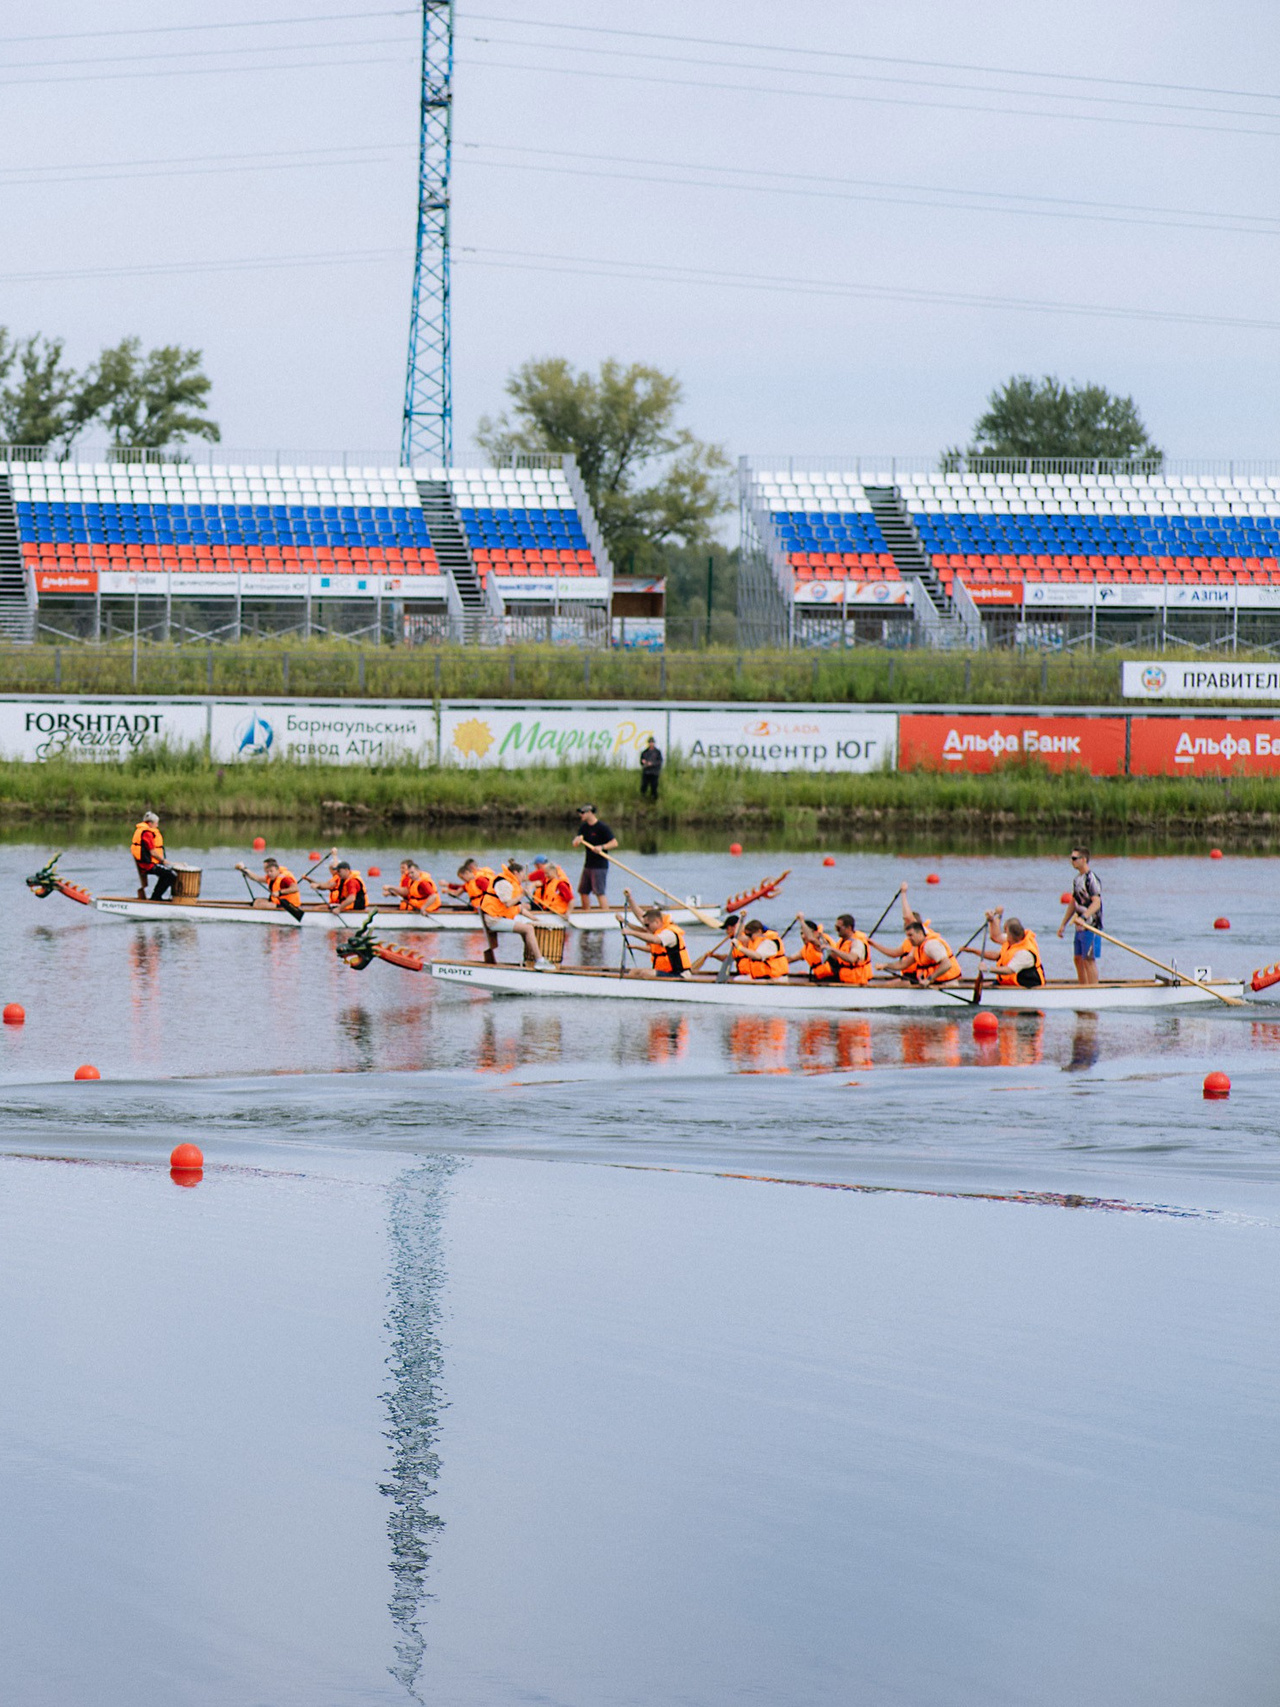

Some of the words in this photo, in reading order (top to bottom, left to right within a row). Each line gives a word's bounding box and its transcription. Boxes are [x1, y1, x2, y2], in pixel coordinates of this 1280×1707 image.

[25, 712, 164, 734] FORSHTADT
[287, 714, 418, 737] Барнаульский
[36, 728, 146, 760] Brewery
[288, 742, 340, 757] завод
[346, 739, 384, 756] АТИ
[691, 739, 827, 763] Автоцентр
[836, 740, 877, 760] ЮГ
[942, 729, 1018, 760] Альфа
[1023, 730, 1081, 754] Банк
[1174, 732, 1252, 763] Альфа
[1197, 968, 1208, 982] 2
